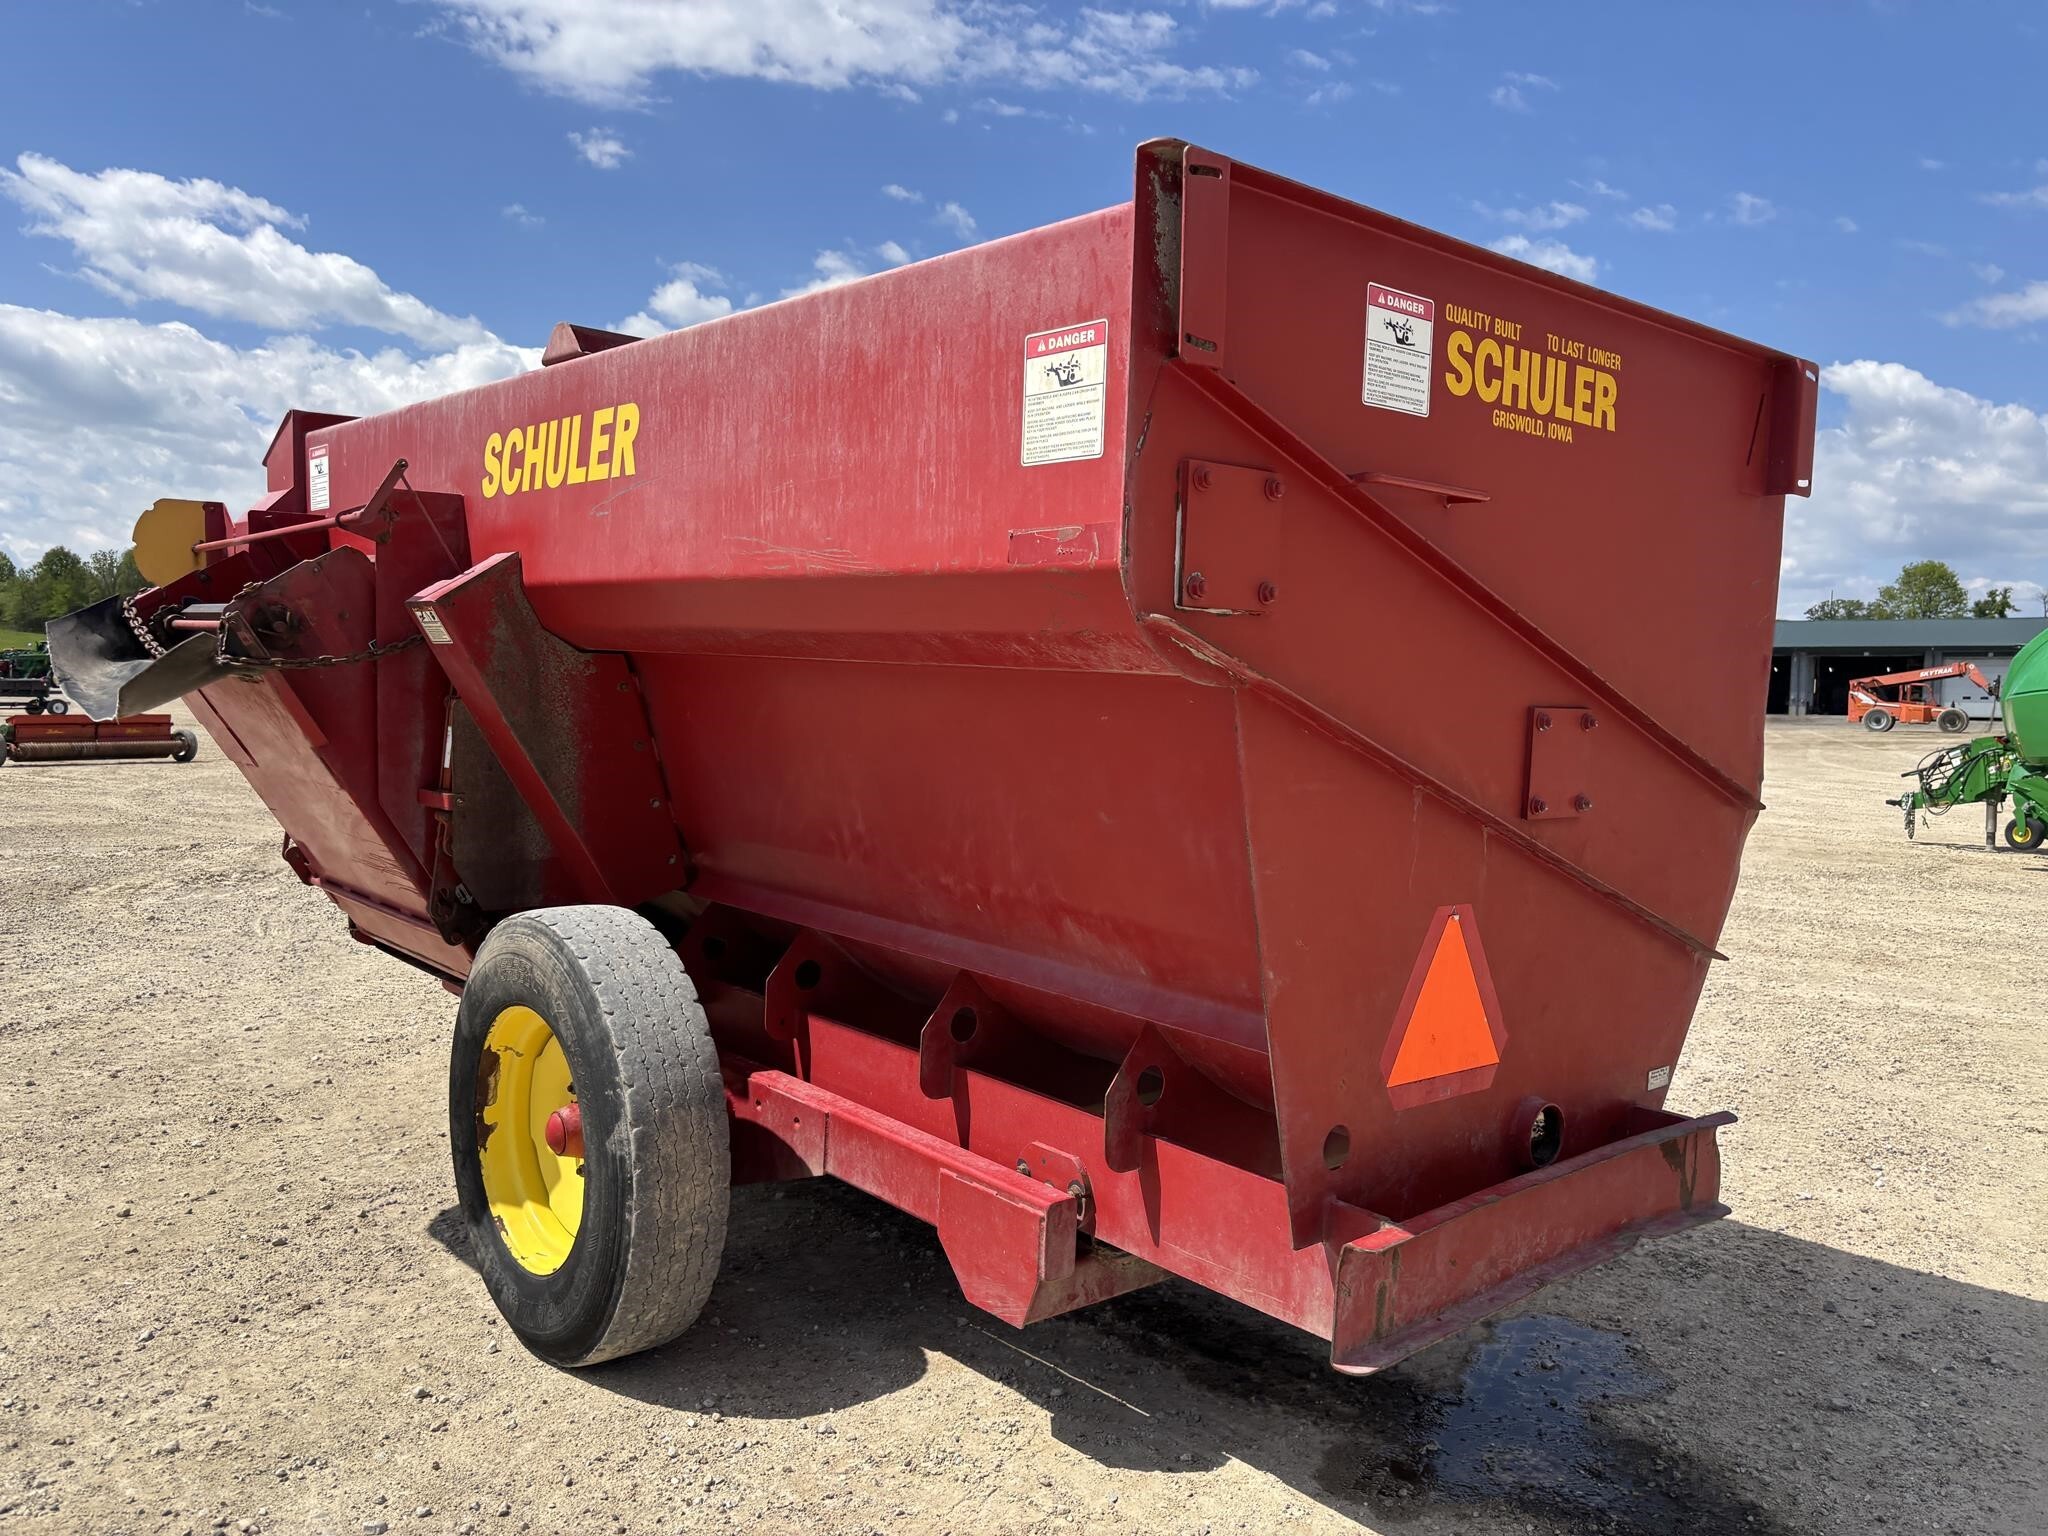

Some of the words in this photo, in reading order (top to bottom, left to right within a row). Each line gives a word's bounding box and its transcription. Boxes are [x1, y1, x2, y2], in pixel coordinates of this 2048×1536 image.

[1387, 295, 1425, 315] DANGER
[1048, 329, 1095, 350] DANGER
[1446, 304, 1491, 332] QUALITY
[1494, 317, 1522, 341] BUILT
[1547, 333, 1559, 352] TO
[1561, 336, 1585, 360] LAST
[1587, 345, 1622, 371] LONGER
[1445, 330, 1618, 432] SCHULER
[1492, 409, 1546, 439] GRISWOLD,
[1548, 422, 1573, 444] IOWA
[482, 402, 640, 499] SCHULER
[1919, 667, 1953, 678] SKYTRAK
